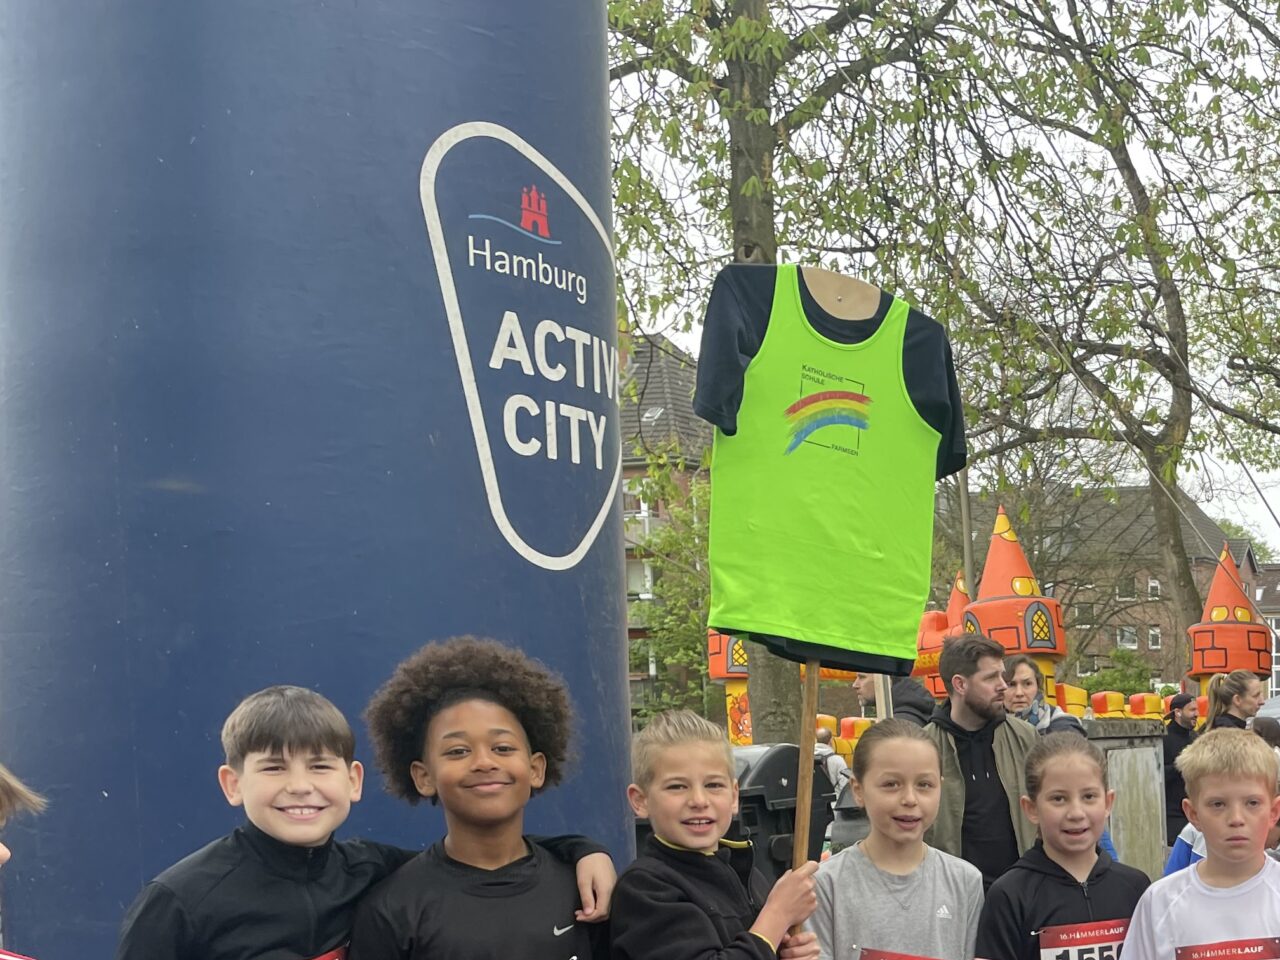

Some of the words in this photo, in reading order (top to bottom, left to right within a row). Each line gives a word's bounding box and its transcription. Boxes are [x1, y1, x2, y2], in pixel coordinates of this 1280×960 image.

[468, 235, 587, 304] Hamburg
[488, 311, 620, 405] ACTIV
[802, 373, 825, 386] SCHULE
[503, 394, 607, 470] CITY
